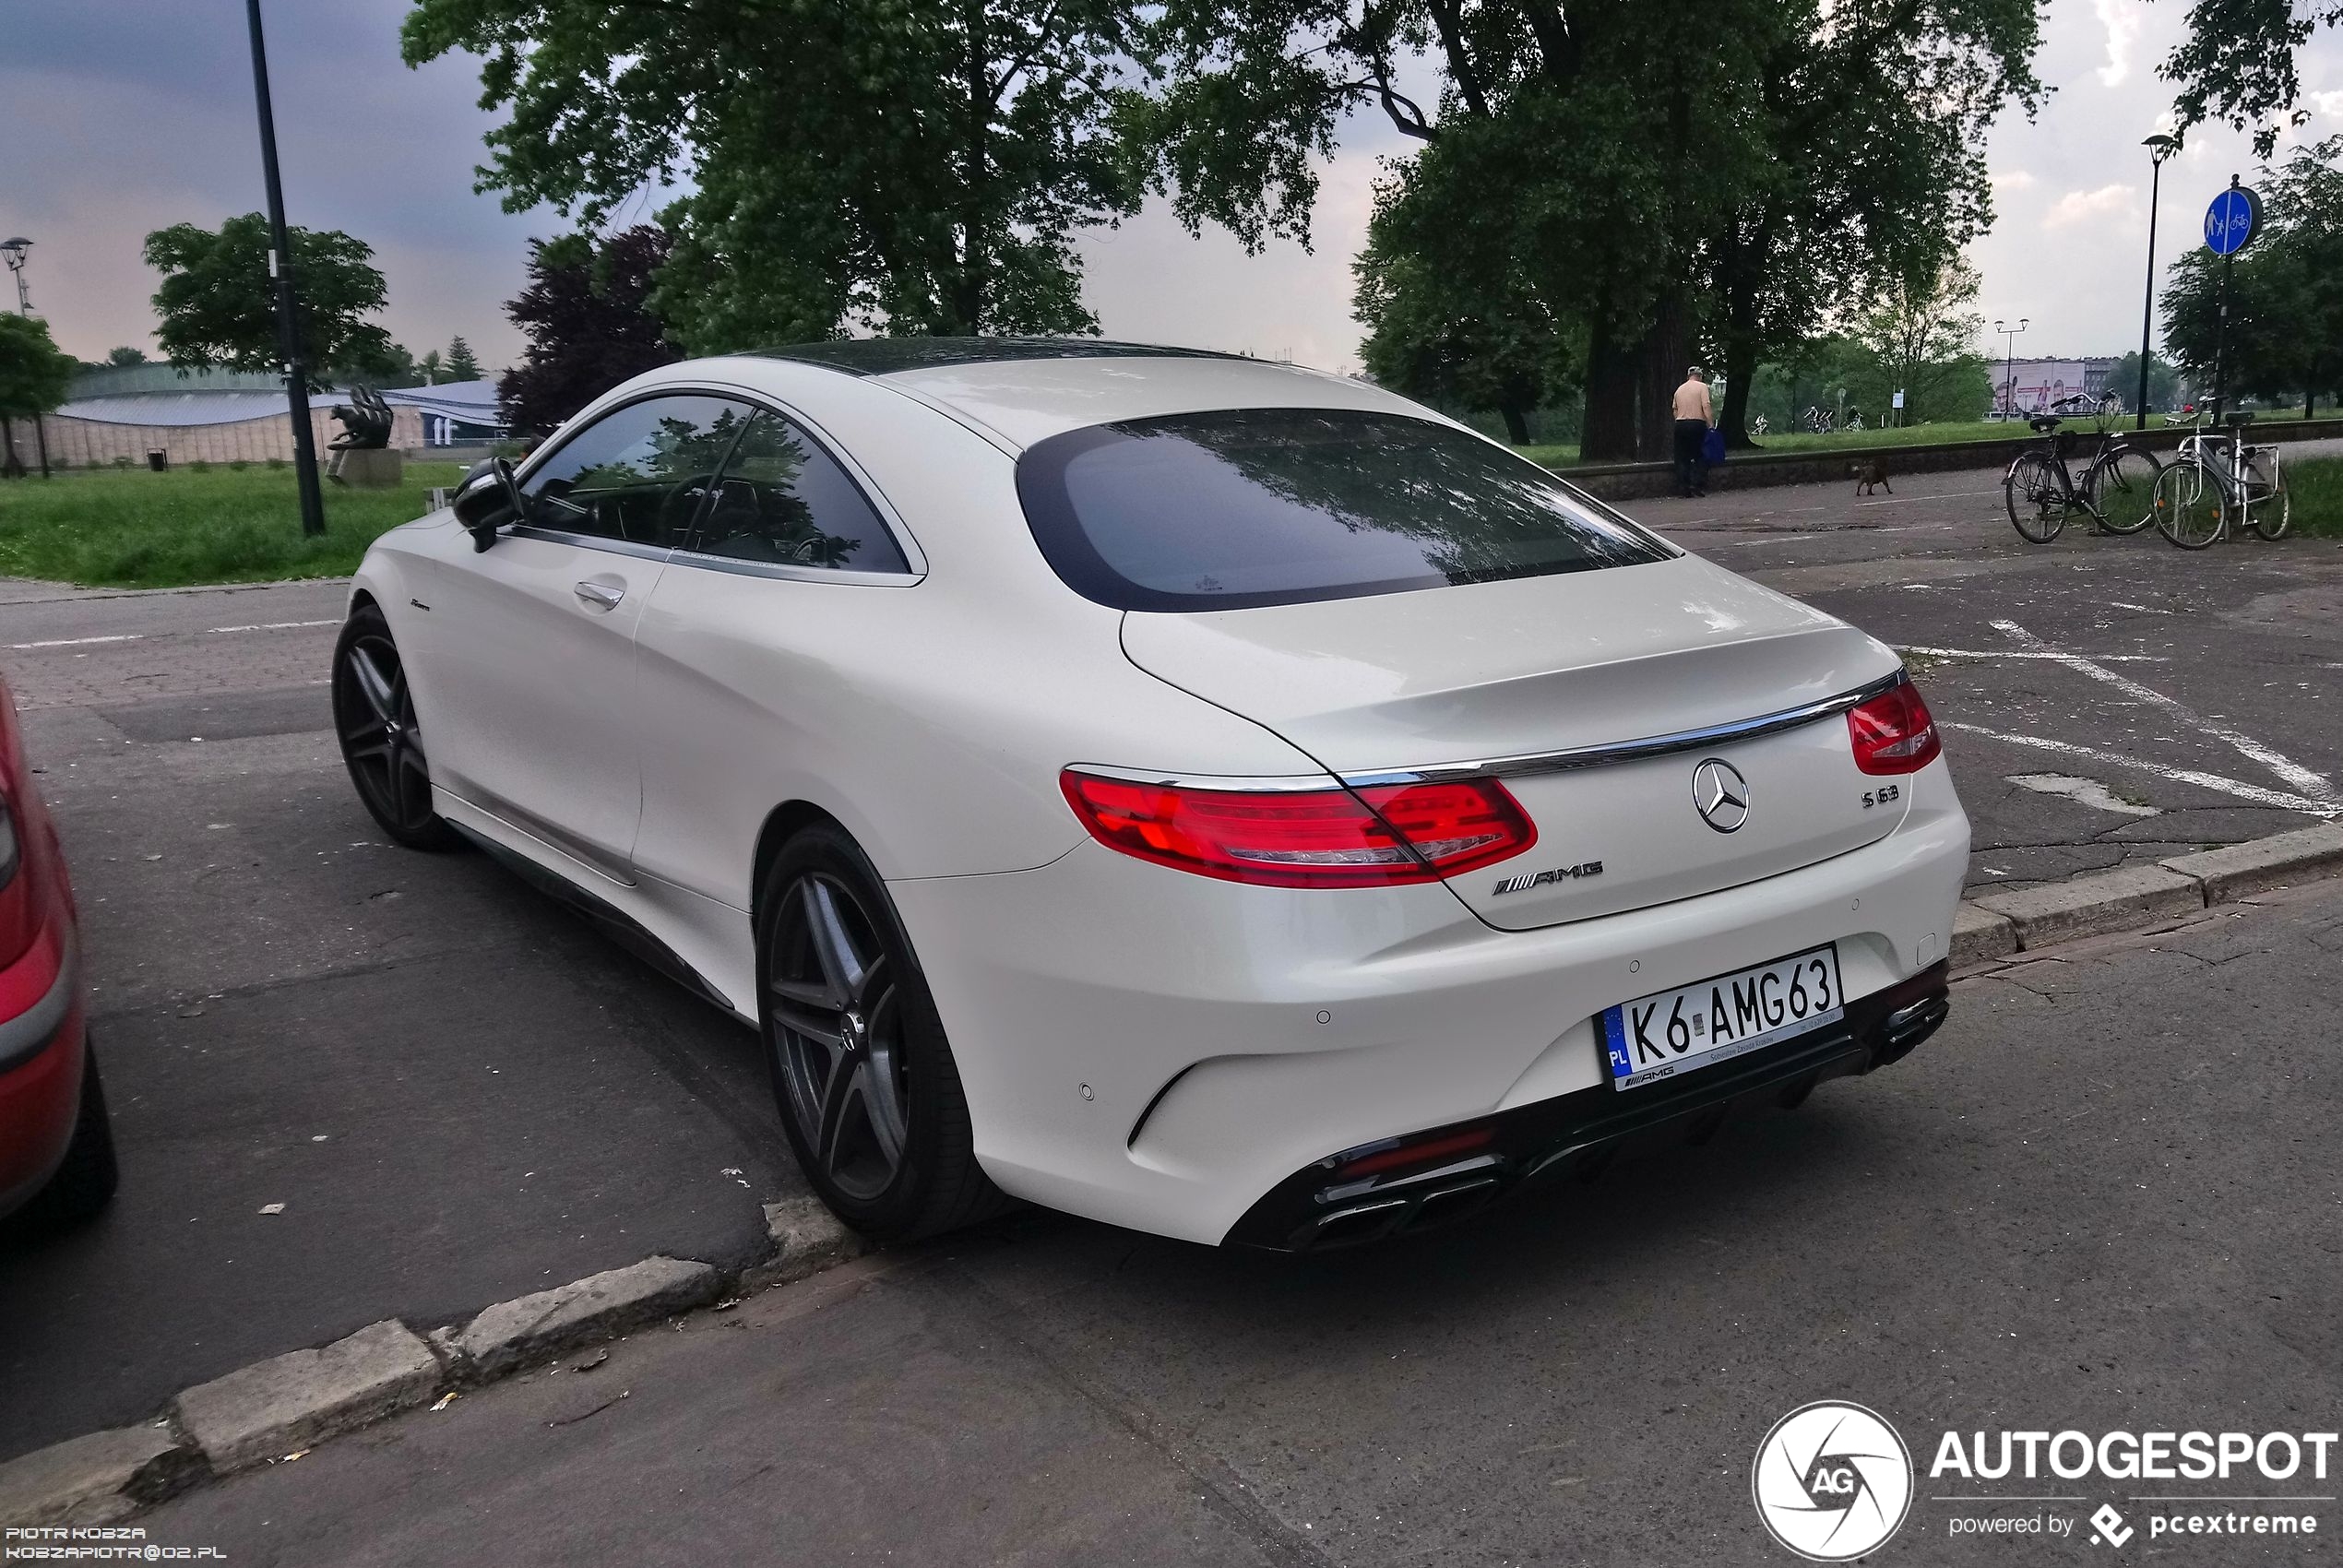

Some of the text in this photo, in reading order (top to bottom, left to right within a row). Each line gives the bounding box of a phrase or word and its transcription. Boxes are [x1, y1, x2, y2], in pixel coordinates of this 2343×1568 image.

[1861, 785, 1899, 808] S 63
[1631, 958, 1831, 1064] K6 AMG63
[1608, 1050, 1628, 1067] PL
